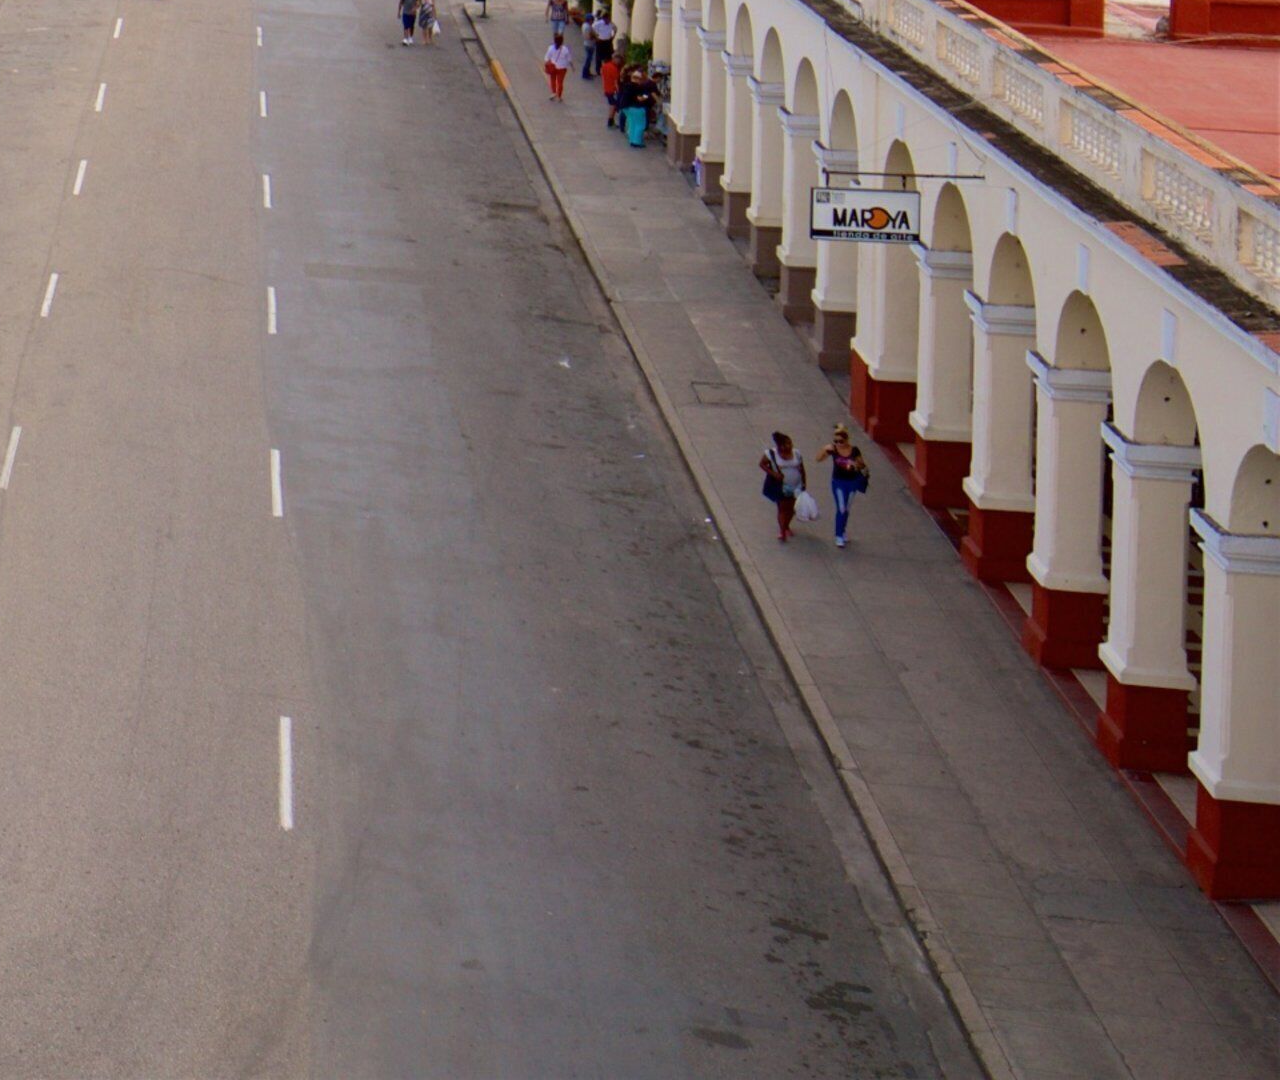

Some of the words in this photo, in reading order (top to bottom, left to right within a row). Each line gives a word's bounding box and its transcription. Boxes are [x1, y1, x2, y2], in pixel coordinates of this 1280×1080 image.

[832, 207, 910, 230] MAROYA
[833, 230, 870, 239] tienda
[873, 232, 887, 240] de
